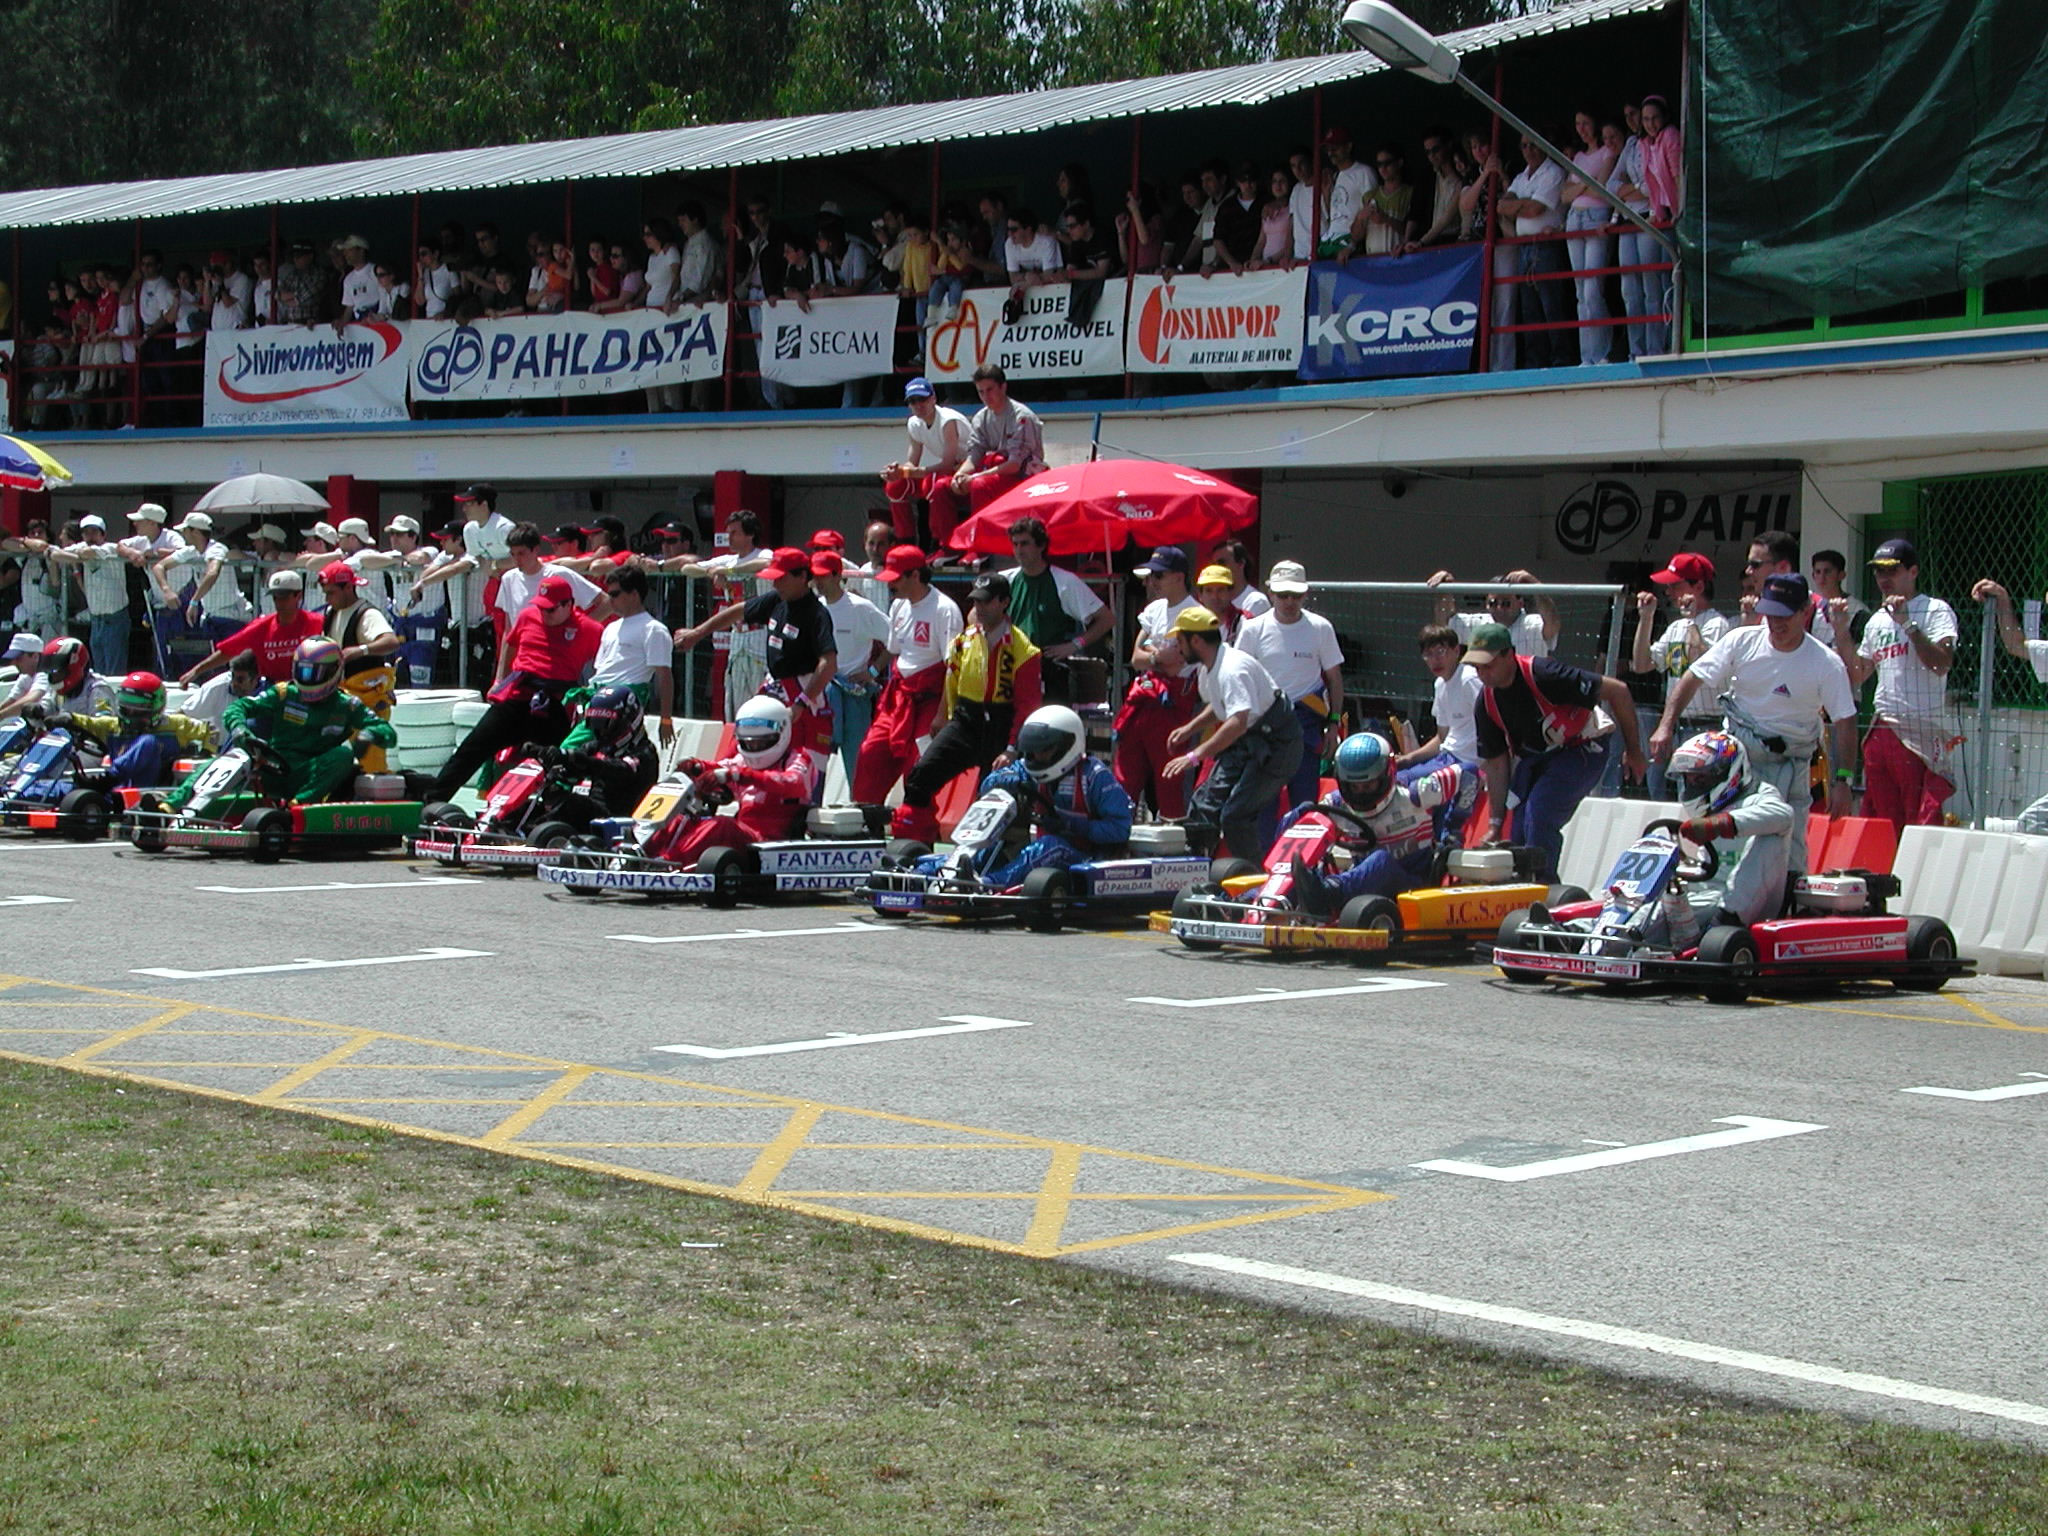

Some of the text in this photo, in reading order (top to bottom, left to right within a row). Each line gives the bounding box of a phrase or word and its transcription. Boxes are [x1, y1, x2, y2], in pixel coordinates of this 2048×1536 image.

[1308, 301, 1477, 346] KCRC
[488, 312, 718, 380] PAHLDATA
[809, 331, 879, 355] SECAM
[233, 340, 374, 382] Divimontagem
[1001, 350, 1083, 370] DE VISEU
[1189, 348, 1292, 364] MATERIAL DE MOTOR
[201, 767, 232, 789] 12
[645, 796, 664, 819] 2
[960, 808, 998, 832] 23
[1614, 853, 1660, 881] 20
